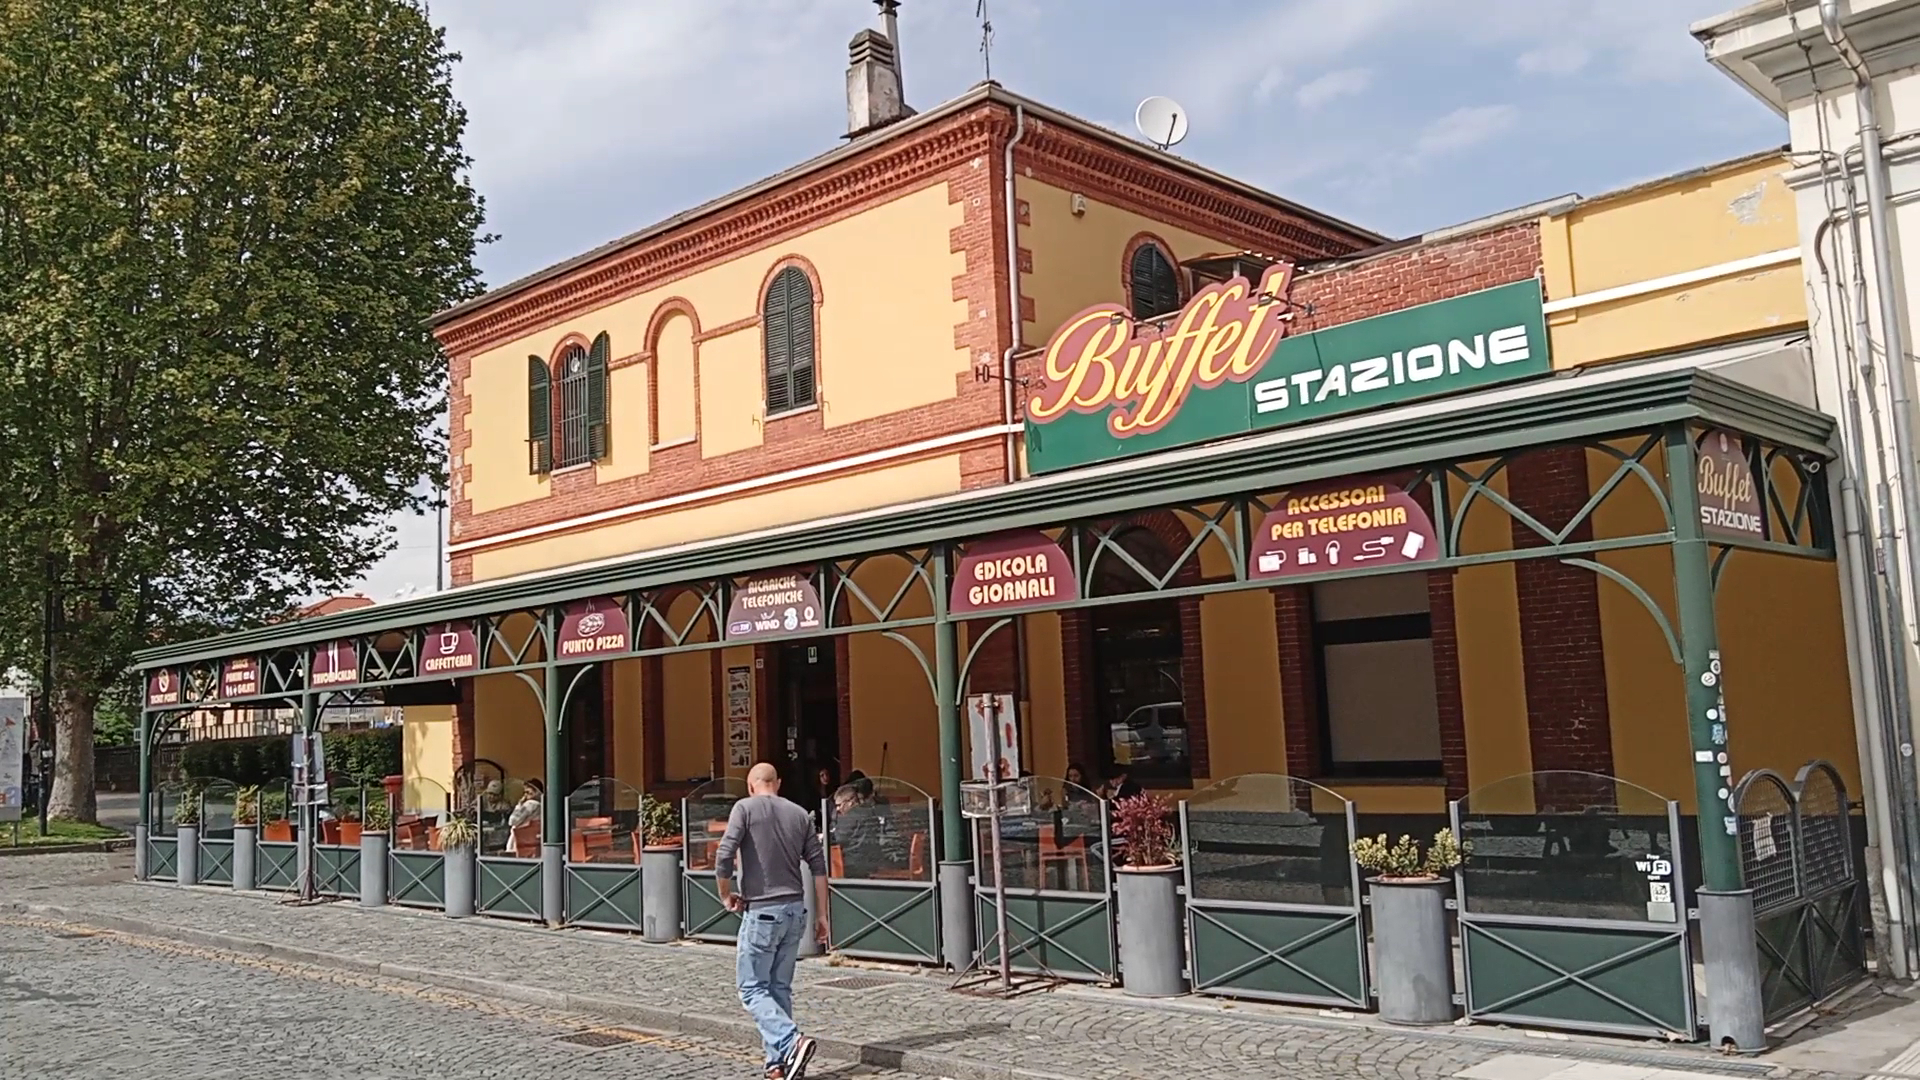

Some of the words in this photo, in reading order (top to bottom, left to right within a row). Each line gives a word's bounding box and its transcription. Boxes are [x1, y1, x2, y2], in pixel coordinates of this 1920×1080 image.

[1030, 271, 1284, 431] Buffet
[1254, 325, 1530, 413] STAZIONE
[1698, 455, 1751, 511] Buffet
[1287, 485, 1385, 516] ACCESSORI
[1271, 523, 1304, 541] PER
[1308, 506, 1407, 536] TELEFONIA
[1700, 505, 1762, 532] STAZIONE
[974, 553, 1048, 581] EDICOLA
[747, 575, 797, 594] RICARICHE
[968, 576, 1056, 605] GIORNALI
[741, 589, 804, 609] TELEFONICHE
[754, 619, 780, 631] WIND
[562, 637, 595, 655] PUNTO
[596, 634, 625, 651] PIZZA
[336, 668, 357, 682] CALDA
[425, 653, 473, 671] CAFFETTERIA
